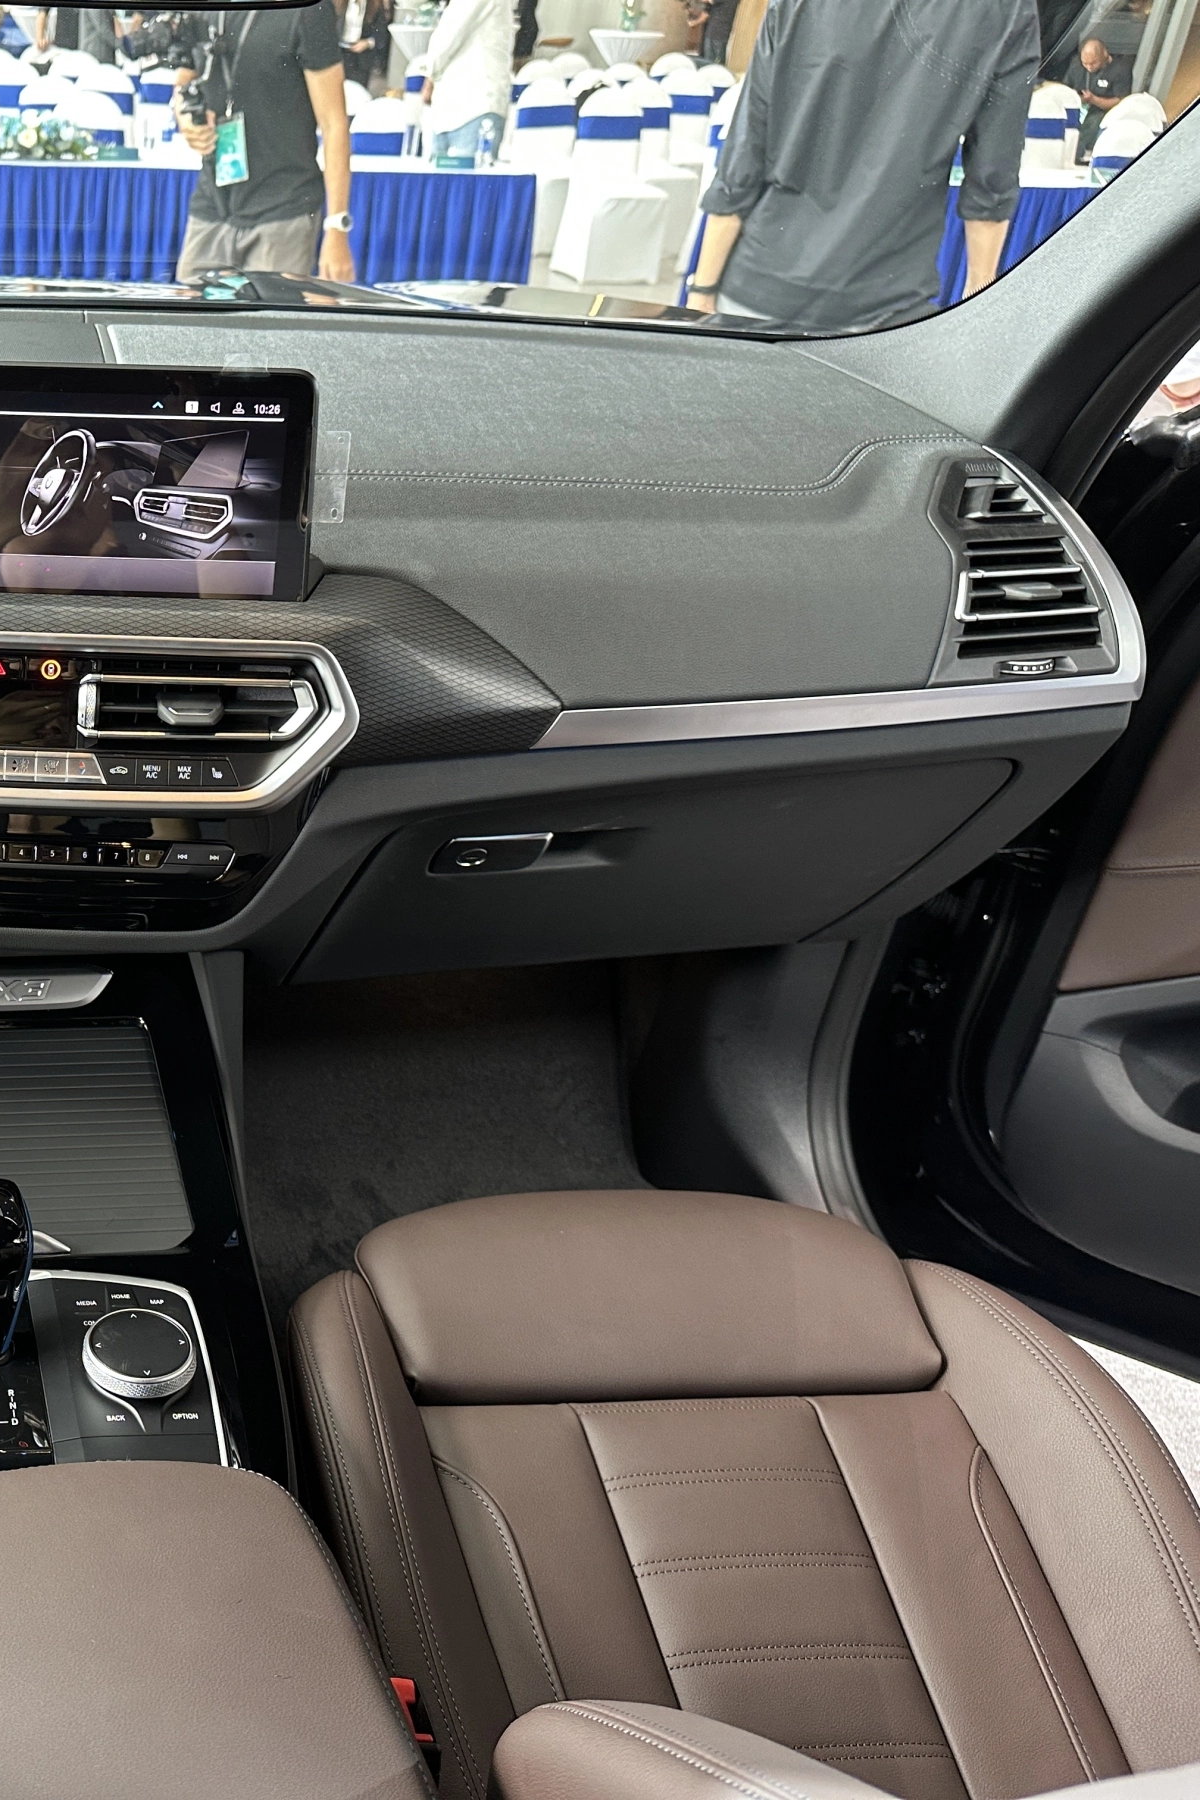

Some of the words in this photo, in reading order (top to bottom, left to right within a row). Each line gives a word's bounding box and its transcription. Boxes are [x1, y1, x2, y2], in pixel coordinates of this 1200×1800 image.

[253, 404, 280, 414] 10:26
[178, 772, 191, 780] A/C
[8, 1389, 15, 1397] R
[9, 1402, 17, 1410] N
[106, 1414, 125, 1422] BACK
[172, 1412, 198, 1421] OPTION
[12, 1418, 19, 1426] D
